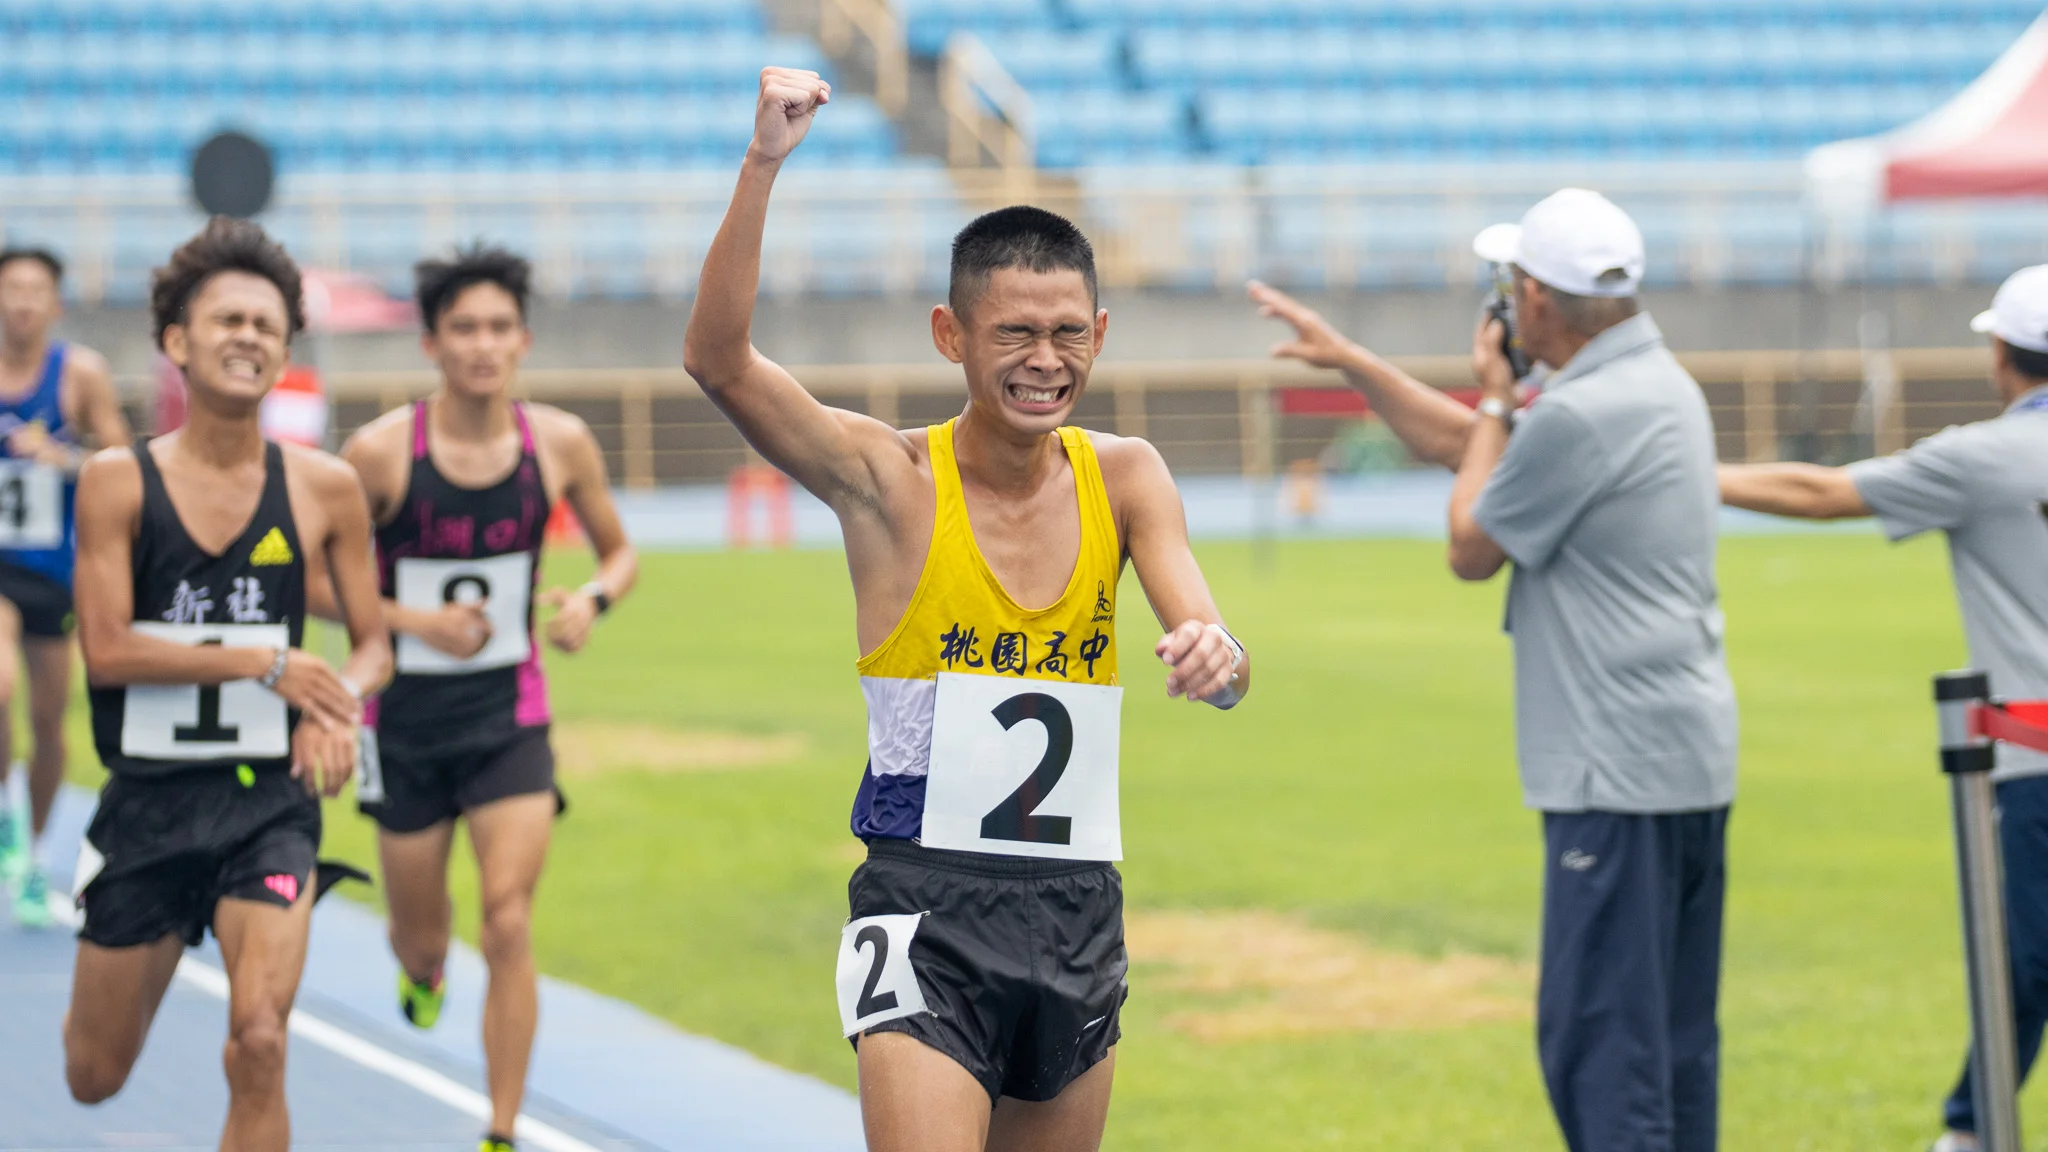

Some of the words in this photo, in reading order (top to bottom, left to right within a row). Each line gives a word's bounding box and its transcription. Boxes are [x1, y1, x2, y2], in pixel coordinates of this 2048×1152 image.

[939, 622, 1110, 678] 桃園高中
[979, 692, 1074, 845] 2
[853, 925, 899, 1020] 2
